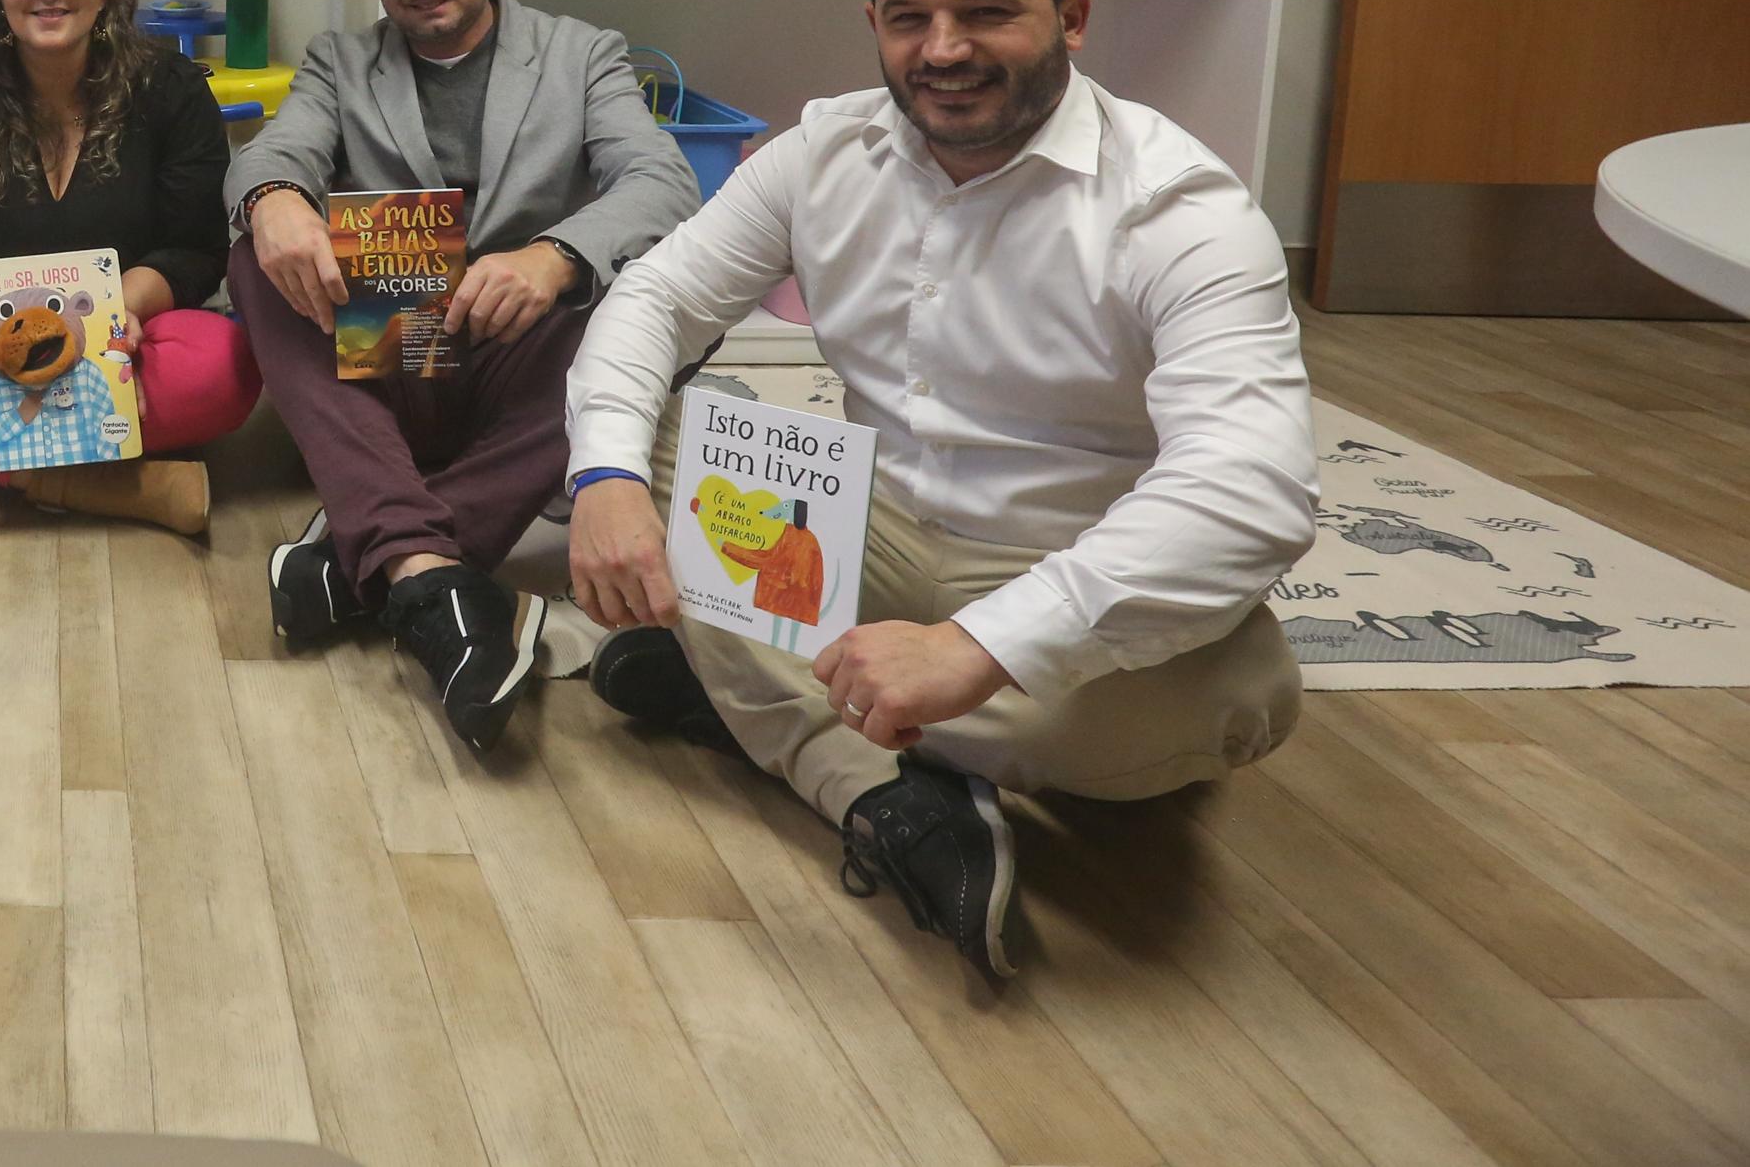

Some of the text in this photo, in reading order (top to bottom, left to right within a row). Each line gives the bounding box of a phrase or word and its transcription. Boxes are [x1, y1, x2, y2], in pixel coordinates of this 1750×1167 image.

[340, 203, 455, 231] AS MAIS
[357, 228, 439, 254] BELAS
[16, 271, 39, 287] SR.
[42, 267, 80, 285] URSO
[351, 252, 449, 278] LENDAS
[376, 277, 448, 297] AÇORES
[706, 404, 845, 462] Isto não é
[702, 443, 840, 497] um livro
[715, 509, 751, 527] ABRAÇO
[732, 499, 746, 511] UM
[710, 522, 766, 549] DISFARÇADO)
